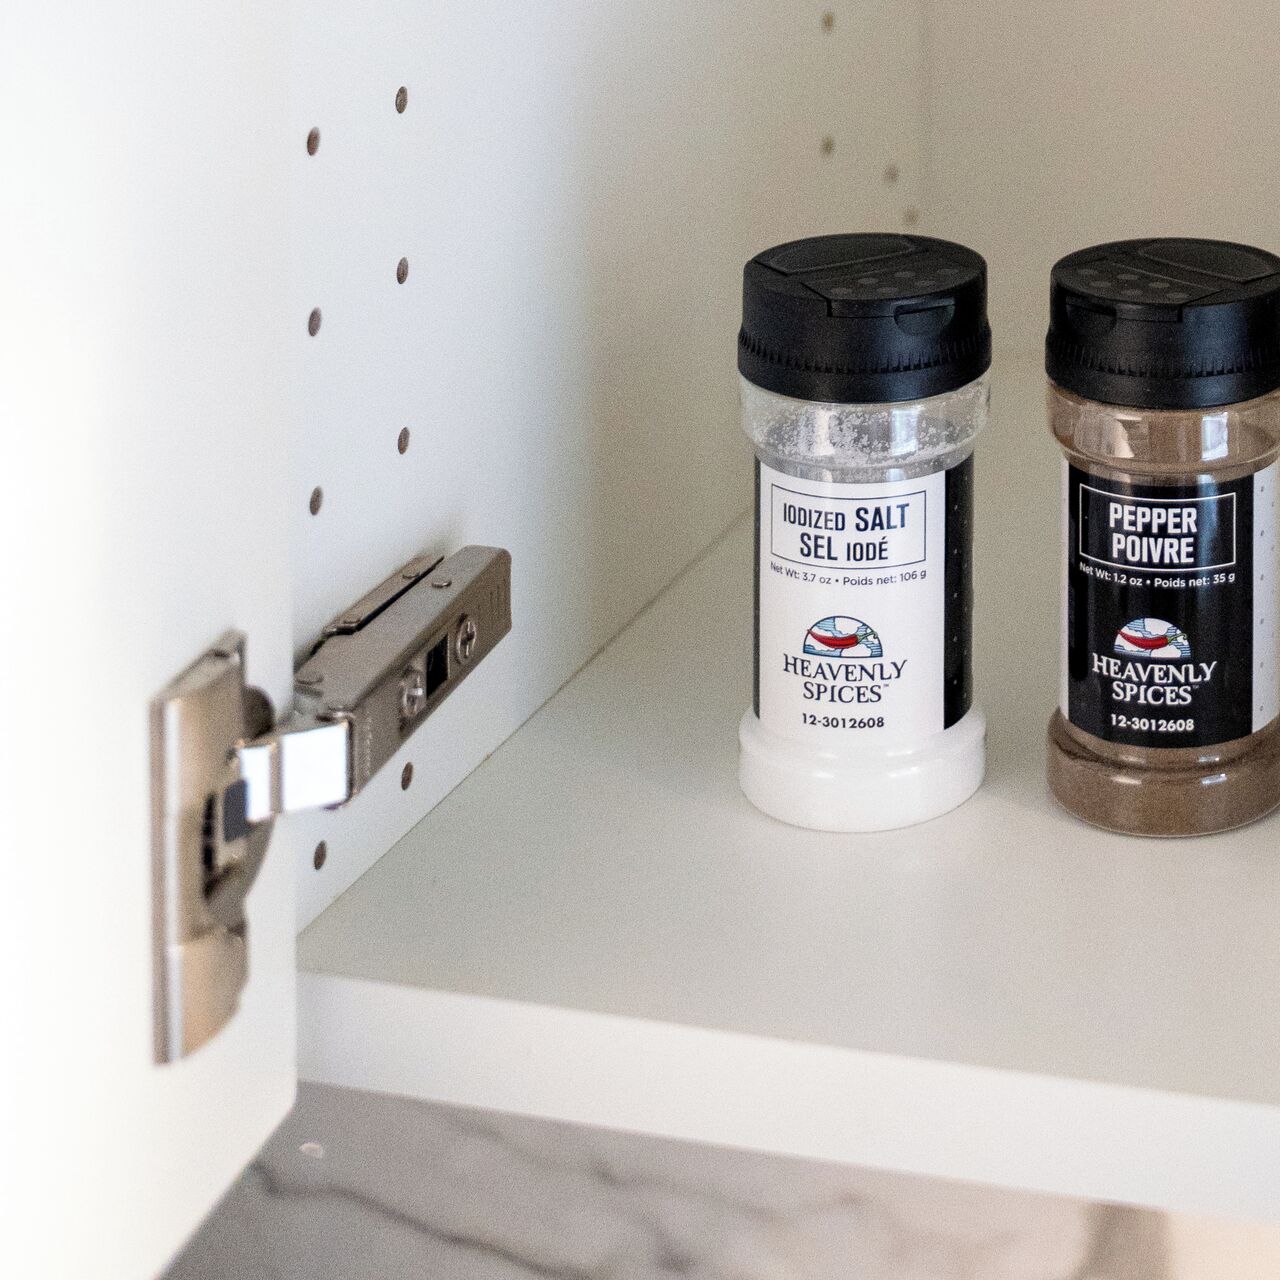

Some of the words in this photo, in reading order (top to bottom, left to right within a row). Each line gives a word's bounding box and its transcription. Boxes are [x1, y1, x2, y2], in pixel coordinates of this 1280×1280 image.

[784, 503, 845, 531] IODIZED
[856, 503, 909, 532] SALT
[1109, 502, 1197, 534] PEPPER
[800, 532, 838, 561] SEL
[847, 536, 888, 561] IODÉ
[1112, 533, 1194, 563] POIVRE
[770, 561, 783, 574] Net
[785, 567, 799, 579] Wt:
[803, 572, 816, 582] 3.7
[820, 576, 832, 585] oz
[843, 577, 873, 586] Poids
[876, 575, 897, 585] net:
[900, 570, 917, 581] 106
[920, 570, 927, 579] g
[1079, 561, 1093, 574] Net
[1095, 568, 1111, 580] Wt:
[1113, 573, 1126, 583] 1.2
[1130, 577, 1142, 585] oz
[1154, 578, 1185, 587] Poids
[1189, 577, 1210, 587] net:
[1213, 574, 1226, 583] 35
[1228, 573, 1235, 582] g
[783, 653, 908, 681] HEAVENLY
[1092, 653, 1217, 684] HEAVENLY
[802, 713, 884, 729] 12-3012608
[1111, 714, 1194, 731] 12-3012608
